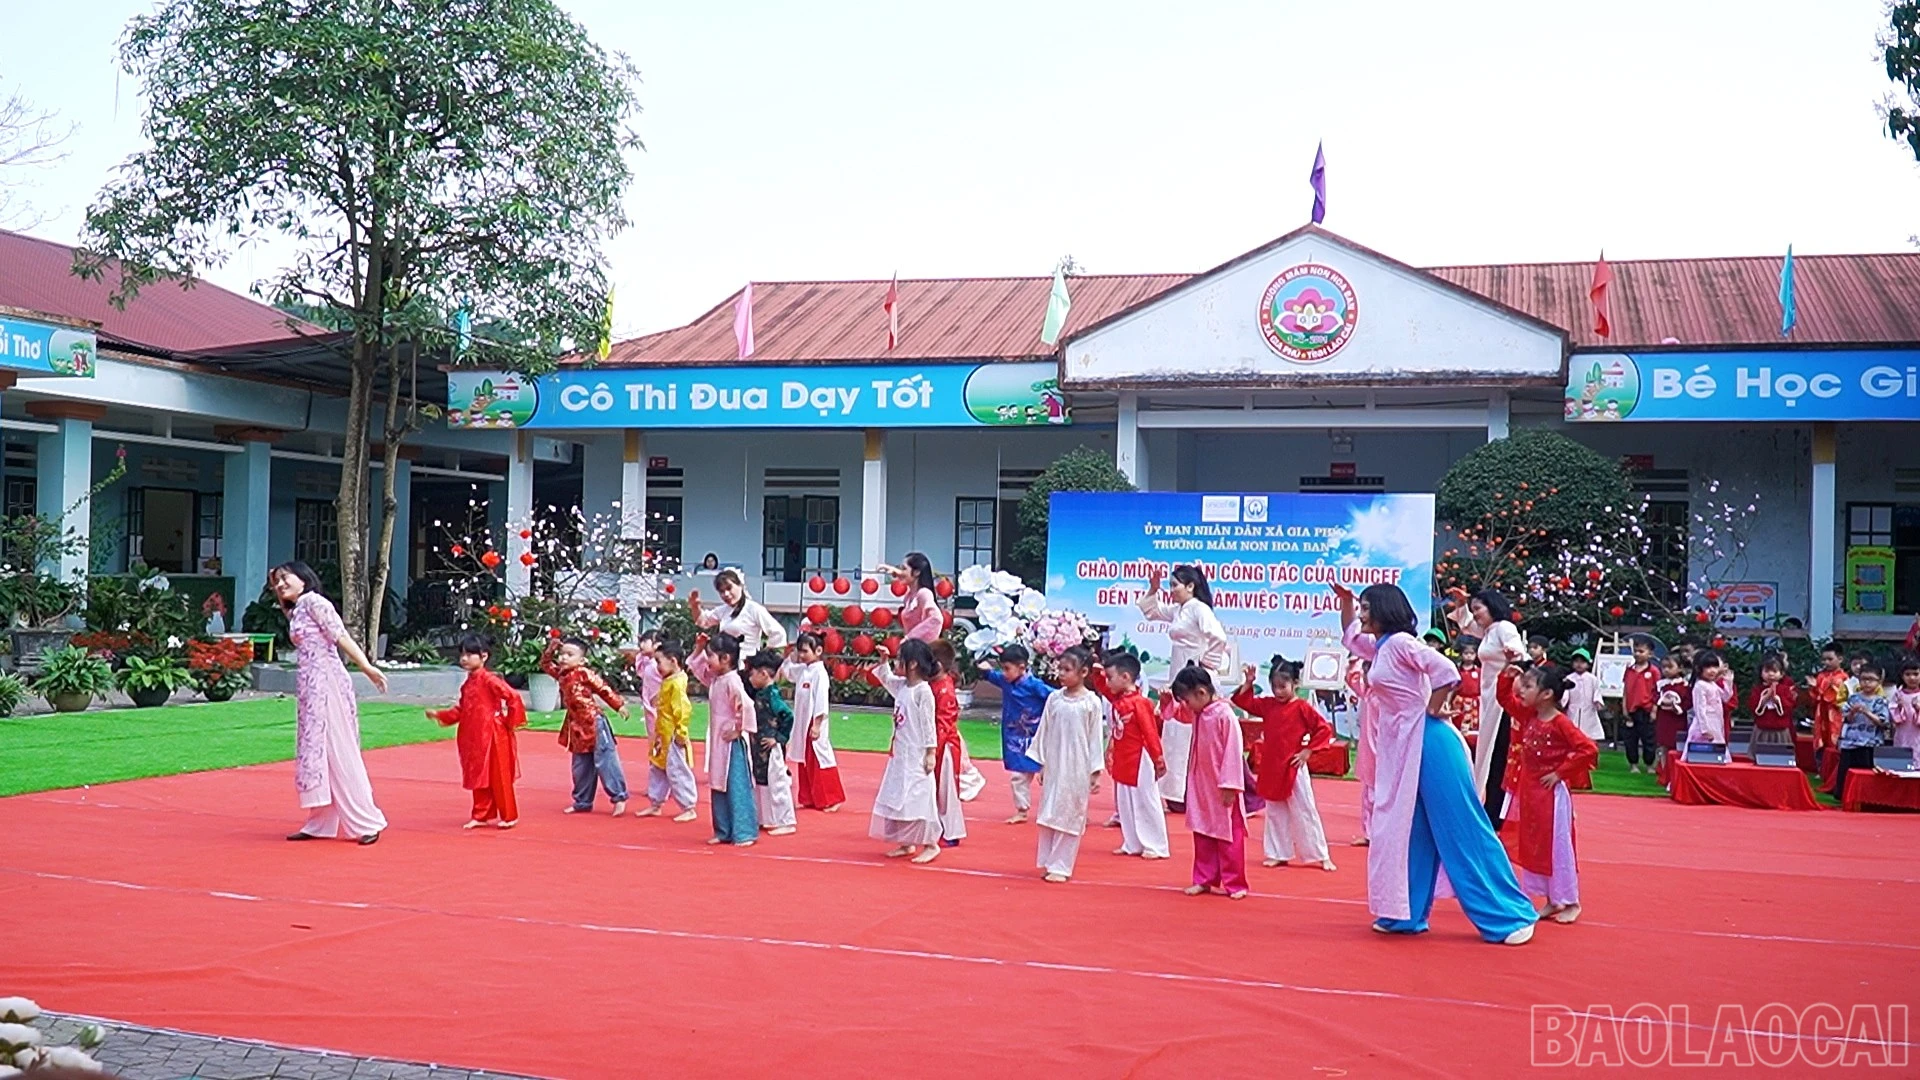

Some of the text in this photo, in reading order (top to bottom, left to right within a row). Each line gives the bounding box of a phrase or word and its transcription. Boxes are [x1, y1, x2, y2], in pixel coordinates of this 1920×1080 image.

[1310, 266, 1331, 278] NON
[1330, 273, 1347, 292] HOA
[1344, 290, 1355, 310] BAN
[1270, 335, 1283, 350] GIA
[1341, 322, 1354, 339] CAI
[12, 334, 41, 360] Thơ
[560, 373, 934, 416] Cô Thi Đua Dạy Tốt
[1653, 364, 1717, 398] Bé
[1736, 367, 1842, 407] Học
[1144, 522, 1162, 536] ỦY
[1165, 526, 1190, 536] BAN
[1194, 524, 1231, 536] NHÂN
[1234, 524, 1262, 536] DÂN
[1265, 525, 1284, 536] XÃ
[1287, 527, 1310, 537] GIA
[1153, 537, 1329, 552] TRƯỜNG MẦM NON HOA BAN
[1078, 558, 1118, 578] CHÀO
[1220, 560, 1263, 581] CÔNG
[1270, 562, 1298, 582] TÁC
[1304, 560, 1336, 583] CỦA
[1342, 566, 1400, 584] UNICEF
[1098, 585, 1128, 604] ĐẾN
[1244, 588, 1278, 613] VIỆC
[1284, 594, 1308, 614] TẠI
[1137, 622, 1154, 633] Gia
[1263, 627, 1276, 637] 02
[1280, 627, 1302, 638] năm
